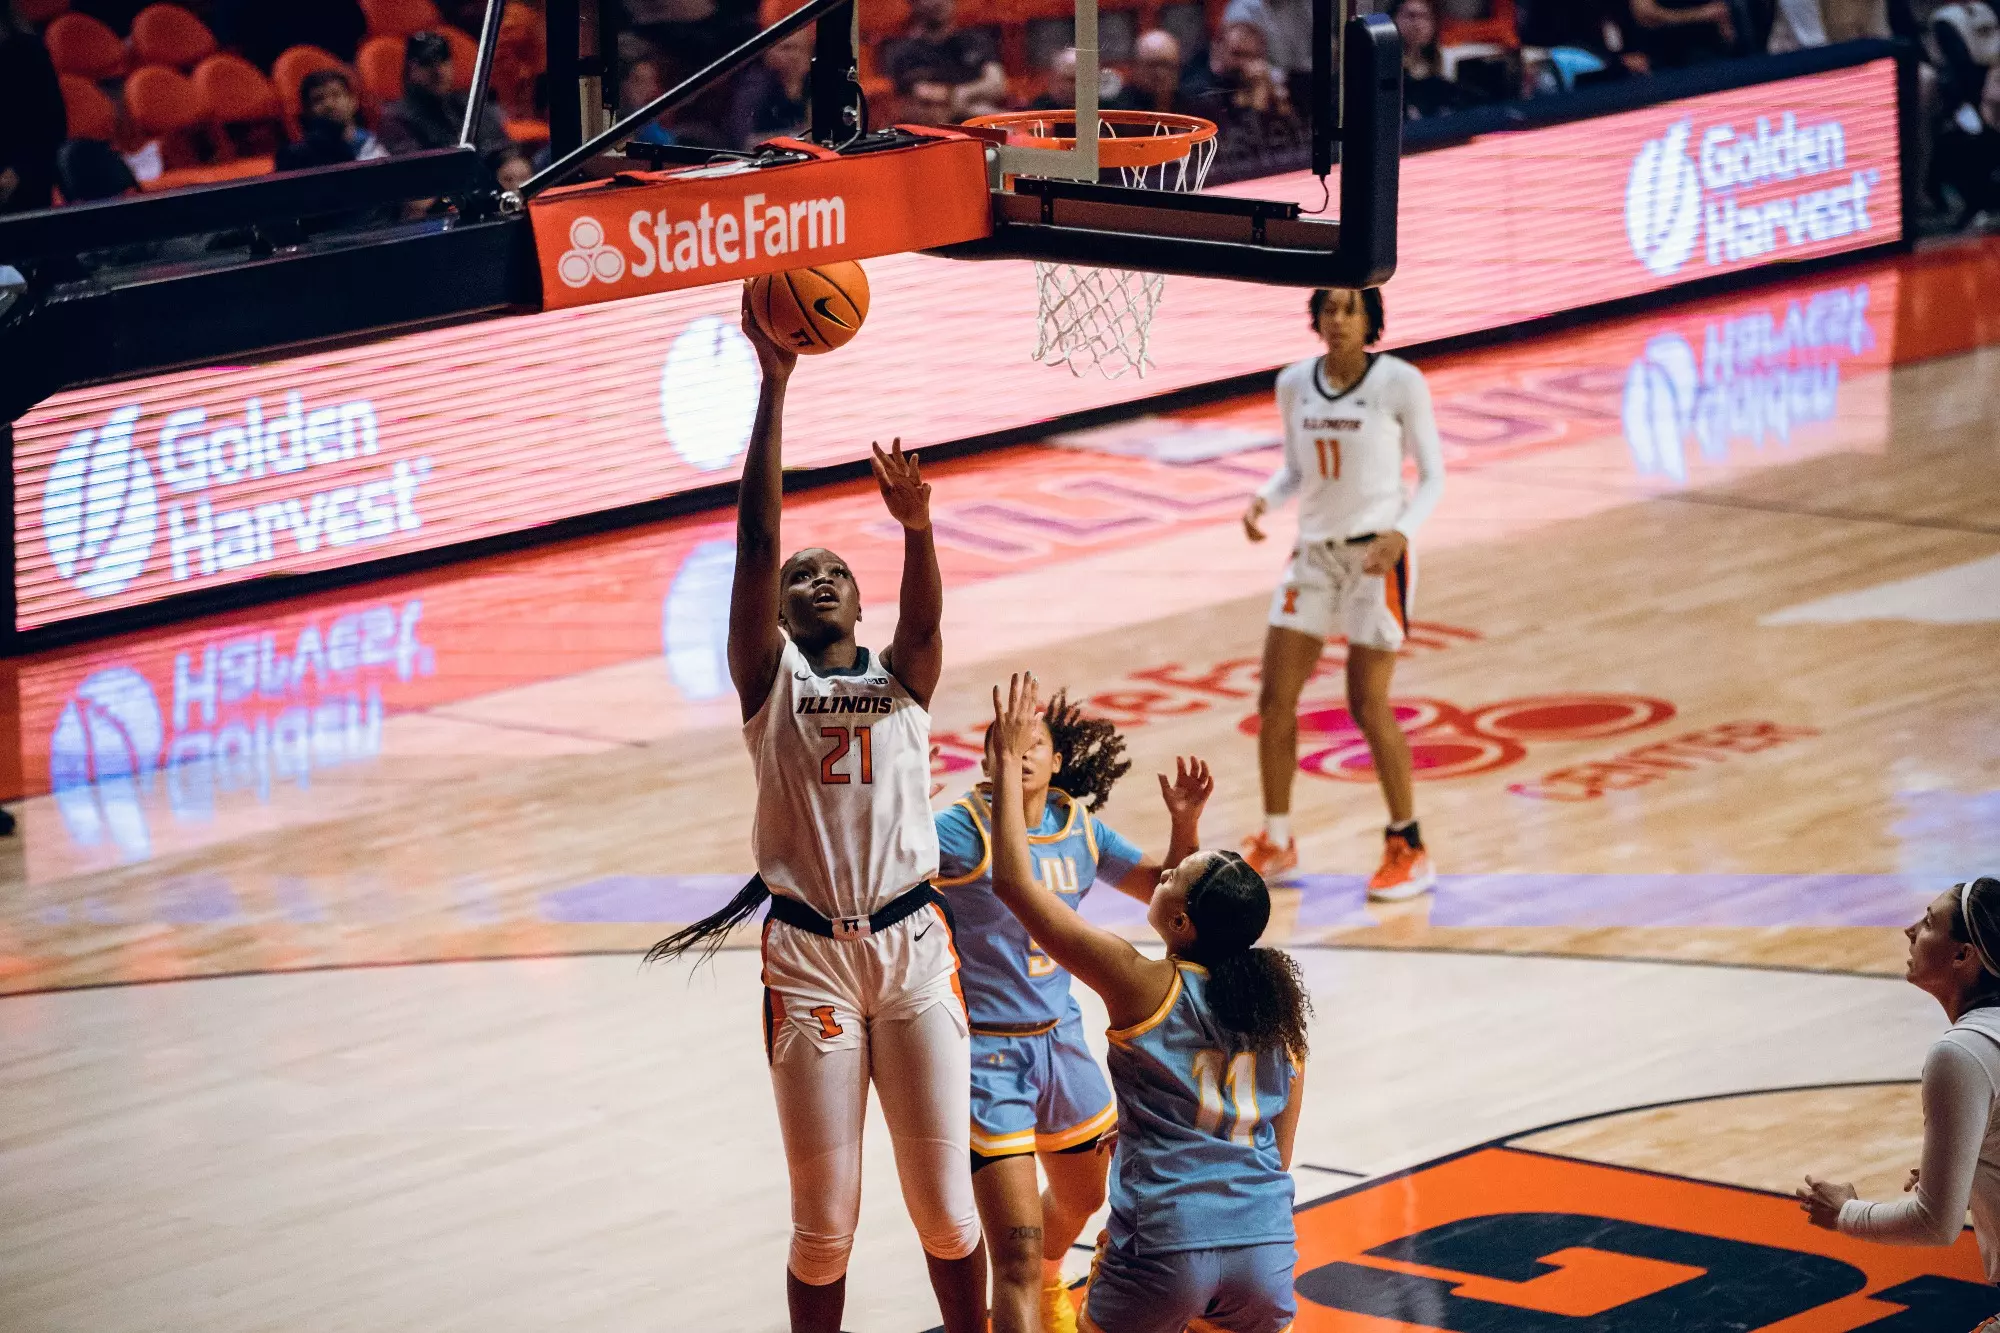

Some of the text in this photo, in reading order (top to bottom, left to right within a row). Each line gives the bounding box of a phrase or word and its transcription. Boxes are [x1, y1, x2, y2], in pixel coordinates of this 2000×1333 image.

[1700, 111, 1846, 191] Golden
[1704, 169, 1878, 266] Harvest
[160, 390, 380, 492] Golden
[1315, 438, 1341, 481] 11
[167, 457, 431, 581] Harvest
[796, 696, 893, 715] ILLINOIS
[821, 726, 873, 784] 21
[810, 1005, 844, 1039] I
[1192, 1050, 1260, 1148] 11
